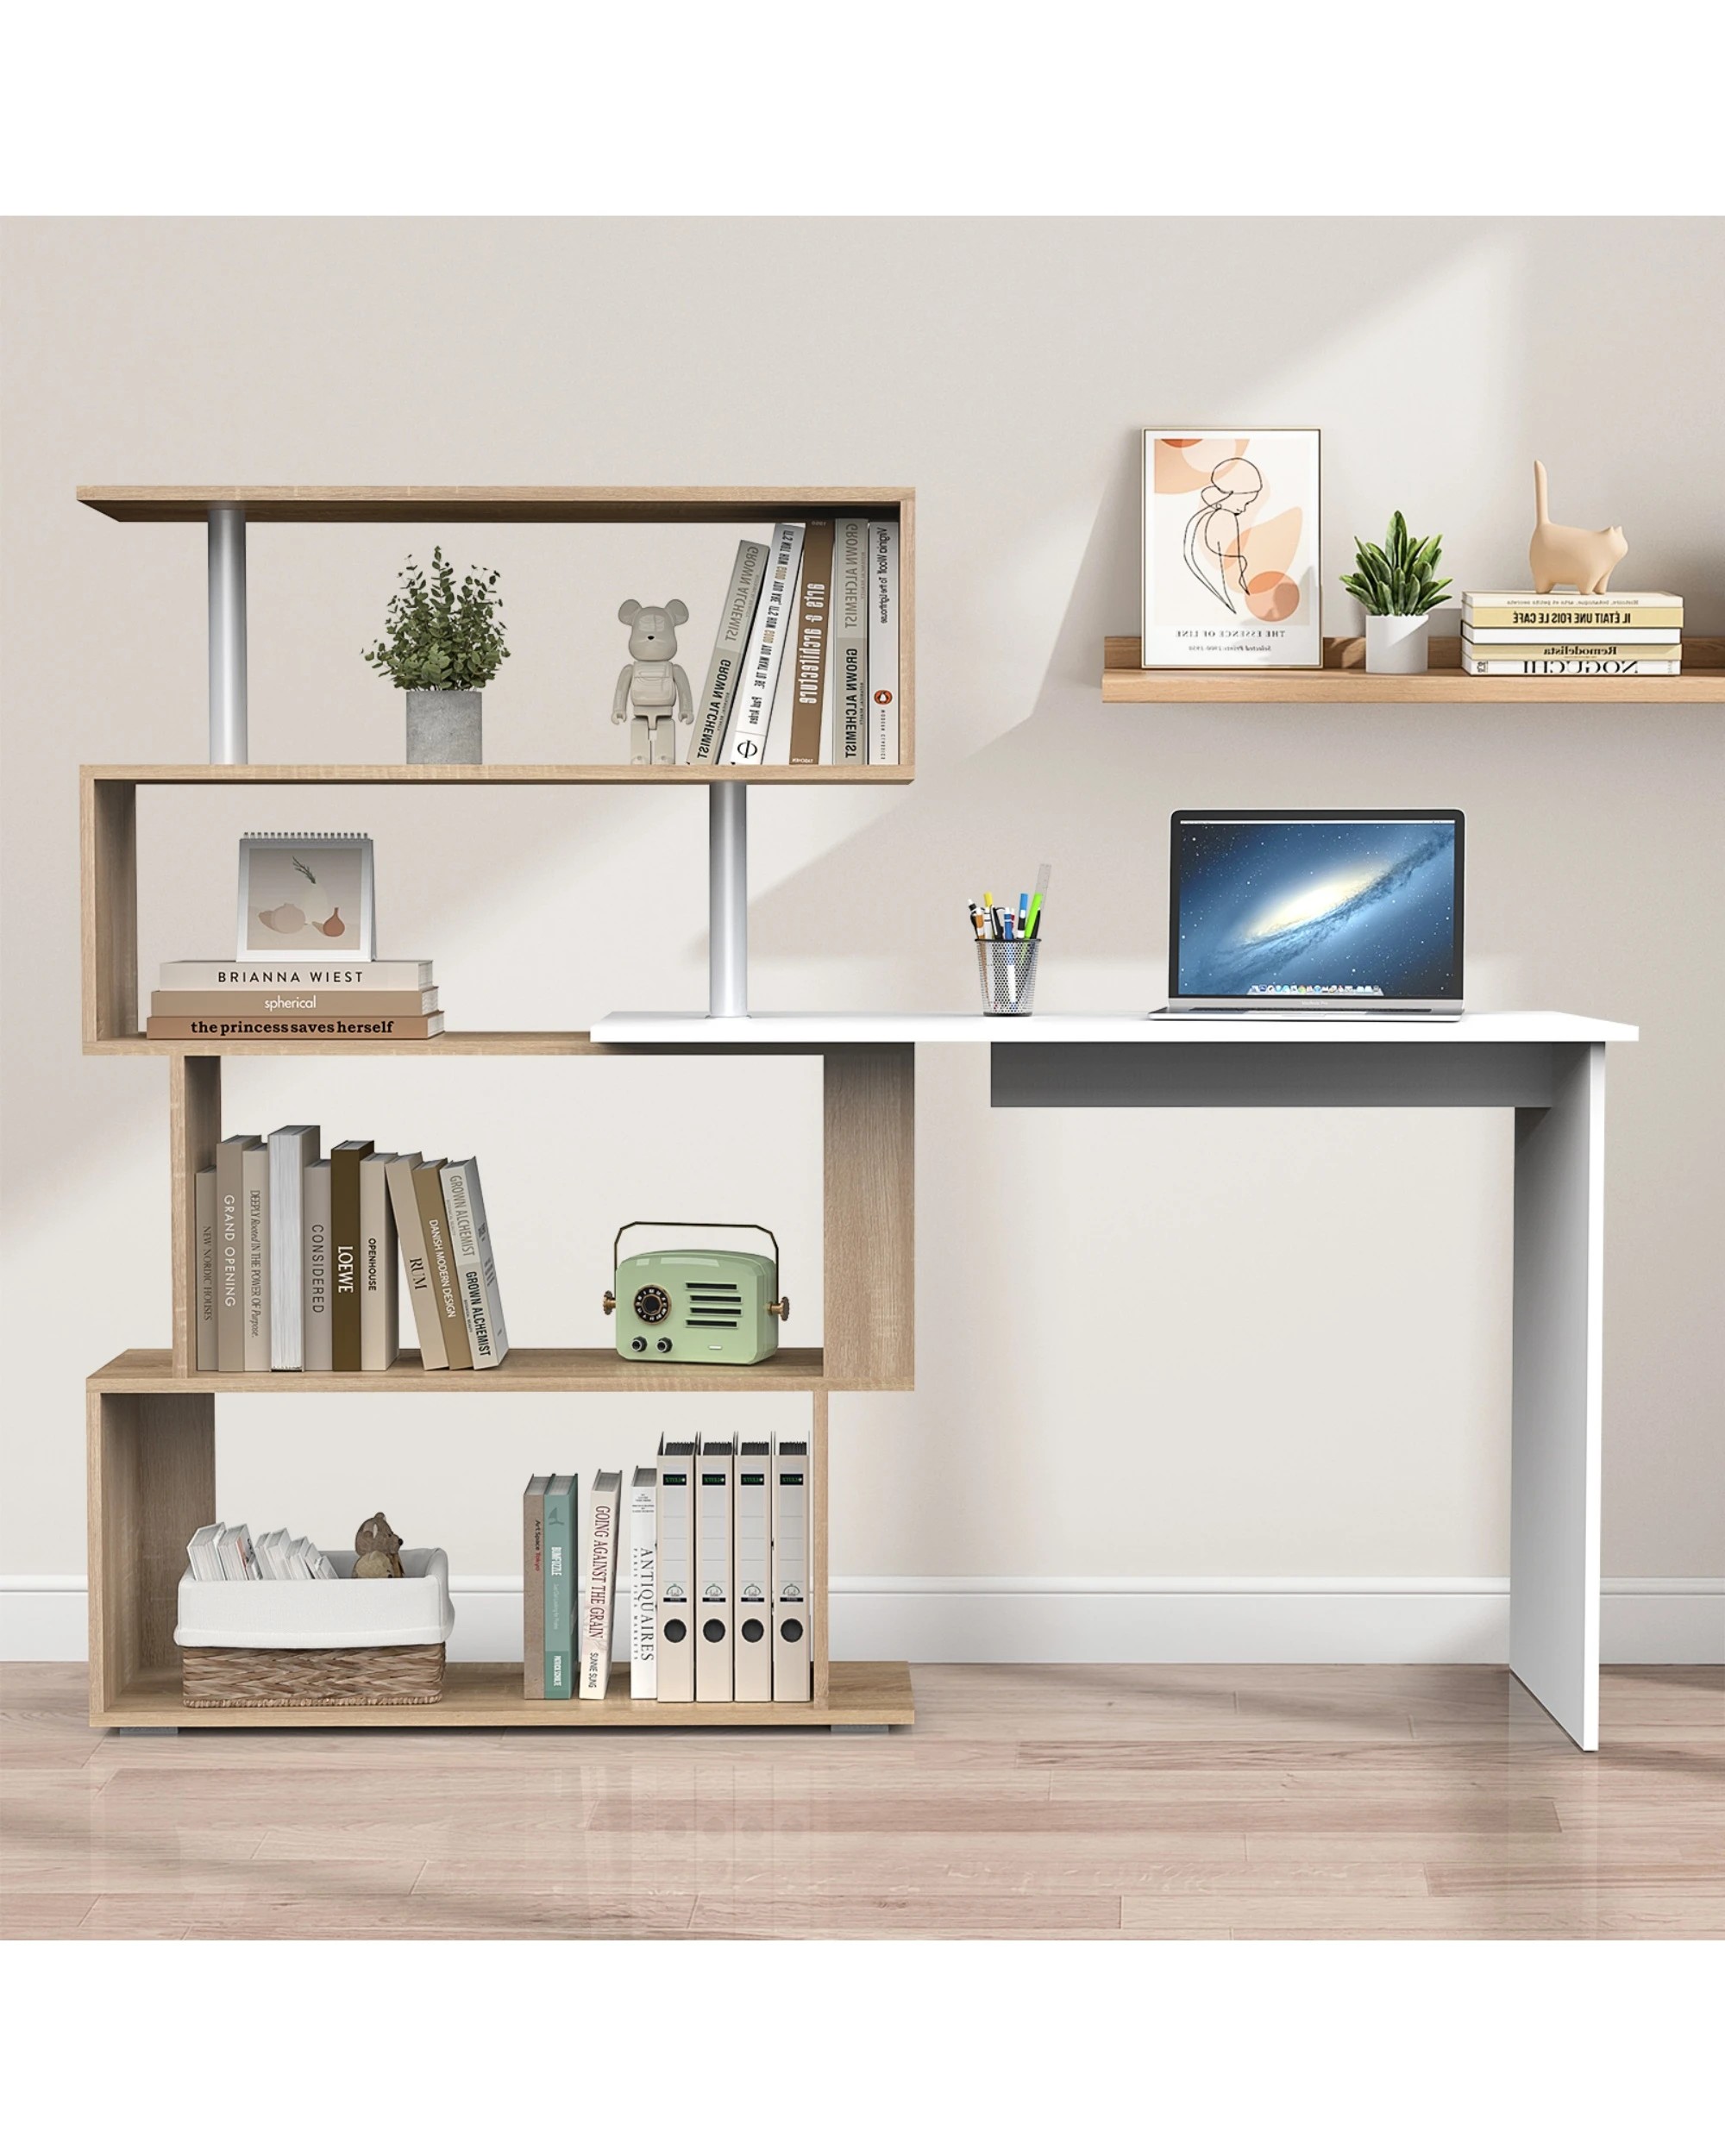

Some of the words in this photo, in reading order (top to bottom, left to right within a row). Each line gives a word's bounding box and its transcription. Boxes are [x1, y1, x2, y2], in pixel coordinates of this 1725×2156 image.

[218, 971, 301, 983] BRIANNA
[310, 971, 364, 983] WIEST
[264, 994, 317, 1012] spherical
[191, 1021, 217, 1033] the
[221, 1021, 288, 1037] princess
[291, 1024, 335, 1033] saves
[336, 1020, 394, 1033] herself
[449, 1175, 467, 1208] GROWN
[224, 1194, 235, 1241] GRAND
[455, 1210, 475, 1256] ALCHEMIST
[203, 1225, 212, 1246] NEW
[429, 1219, 443, 1250] DANISH
[203, 1249, 212, 1285] NORDIC
[224, 1246, 236, 1307] OPENING
[251, 1253, 261, 1268] THE
[311, 1224, 324, 1313] CONSIDERED
[337, 1245, 354, 1293] LOEWE
[367, 1238, 377, 1291] OPENHOUSE
[409, 1257, 428, 1290] RUM
[435, 1251, 450, 1287] MODERN
[251, 1269, 261, 1296] POWER
[465, 1271, 482, 1305] GROWN
[251, 1297, 261, 1308] OF
[442, 1288, 456, 1319] DESIGN
[472, 1307, 492, 1357] ALCHEMIST
[593, 1505, 611, 1538] GOING
[591, 1539, 609, 1583] AGAINST
[590, 1585, 606, 1605] THE
[637, 1547, 655, 1661] ANTIQUAIRES
[589, 1607, 605, 1639] GRAIN
